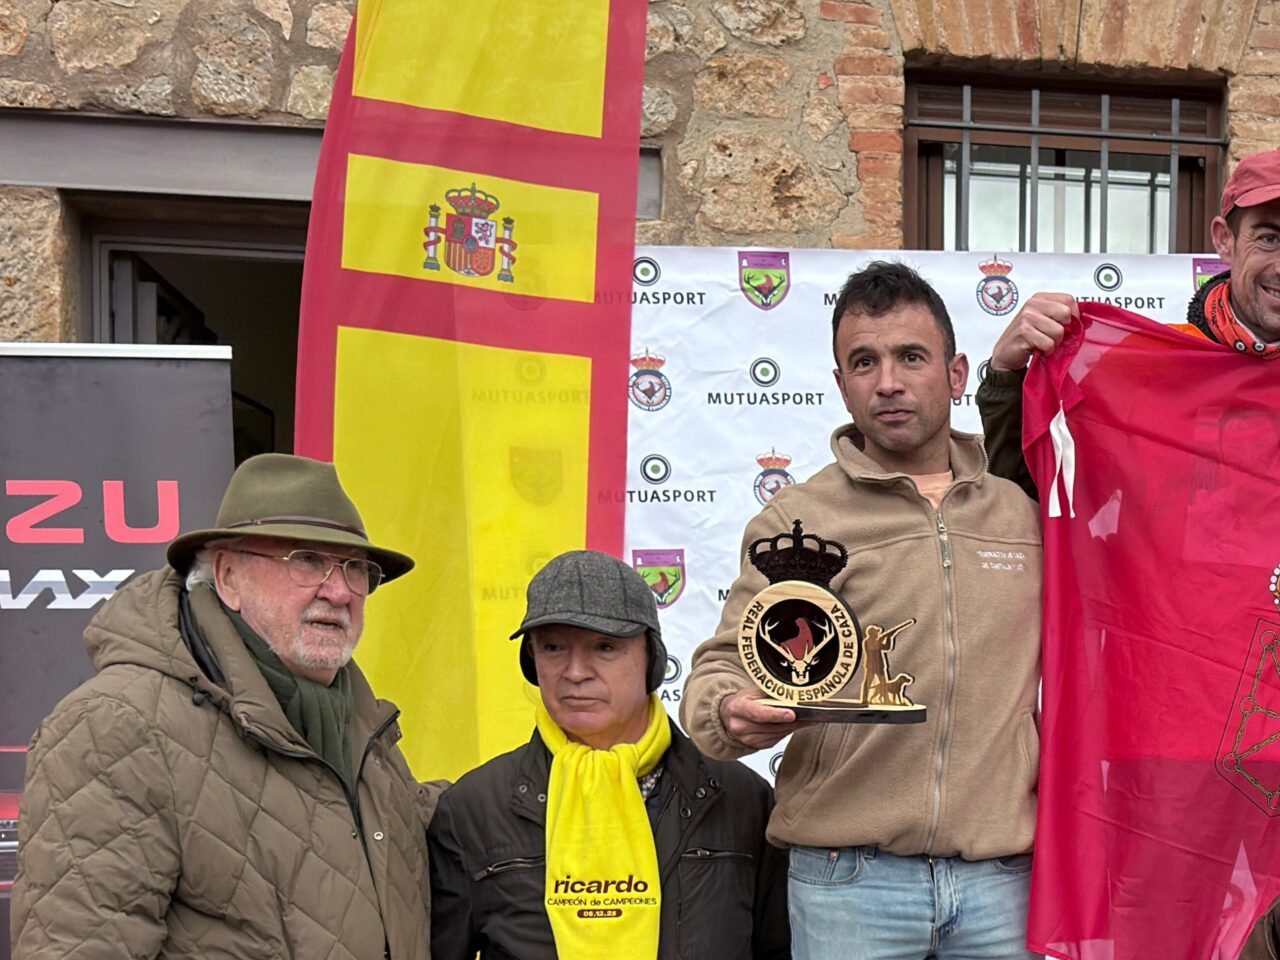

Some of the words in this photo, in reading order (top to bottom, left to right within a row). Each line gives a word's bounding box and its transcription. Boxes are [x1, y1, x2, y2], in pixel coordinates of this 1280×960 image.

[708, 392, 824, 405] MUTUASPORT
[743, 601, 764, 635] REAL
[830, 604, 853, 638] CAZA
[843, 641, 854, 662] DE
[742, 636, 795, 701] FEDERACIÓN
[798, 662, 852, 701] ESPAÑOLA
[554, 874, 648, 894] ricardo
[547, 896, 587, 906] CAMPEÓN
[603, 898, 657, 906] CAMPEONES
